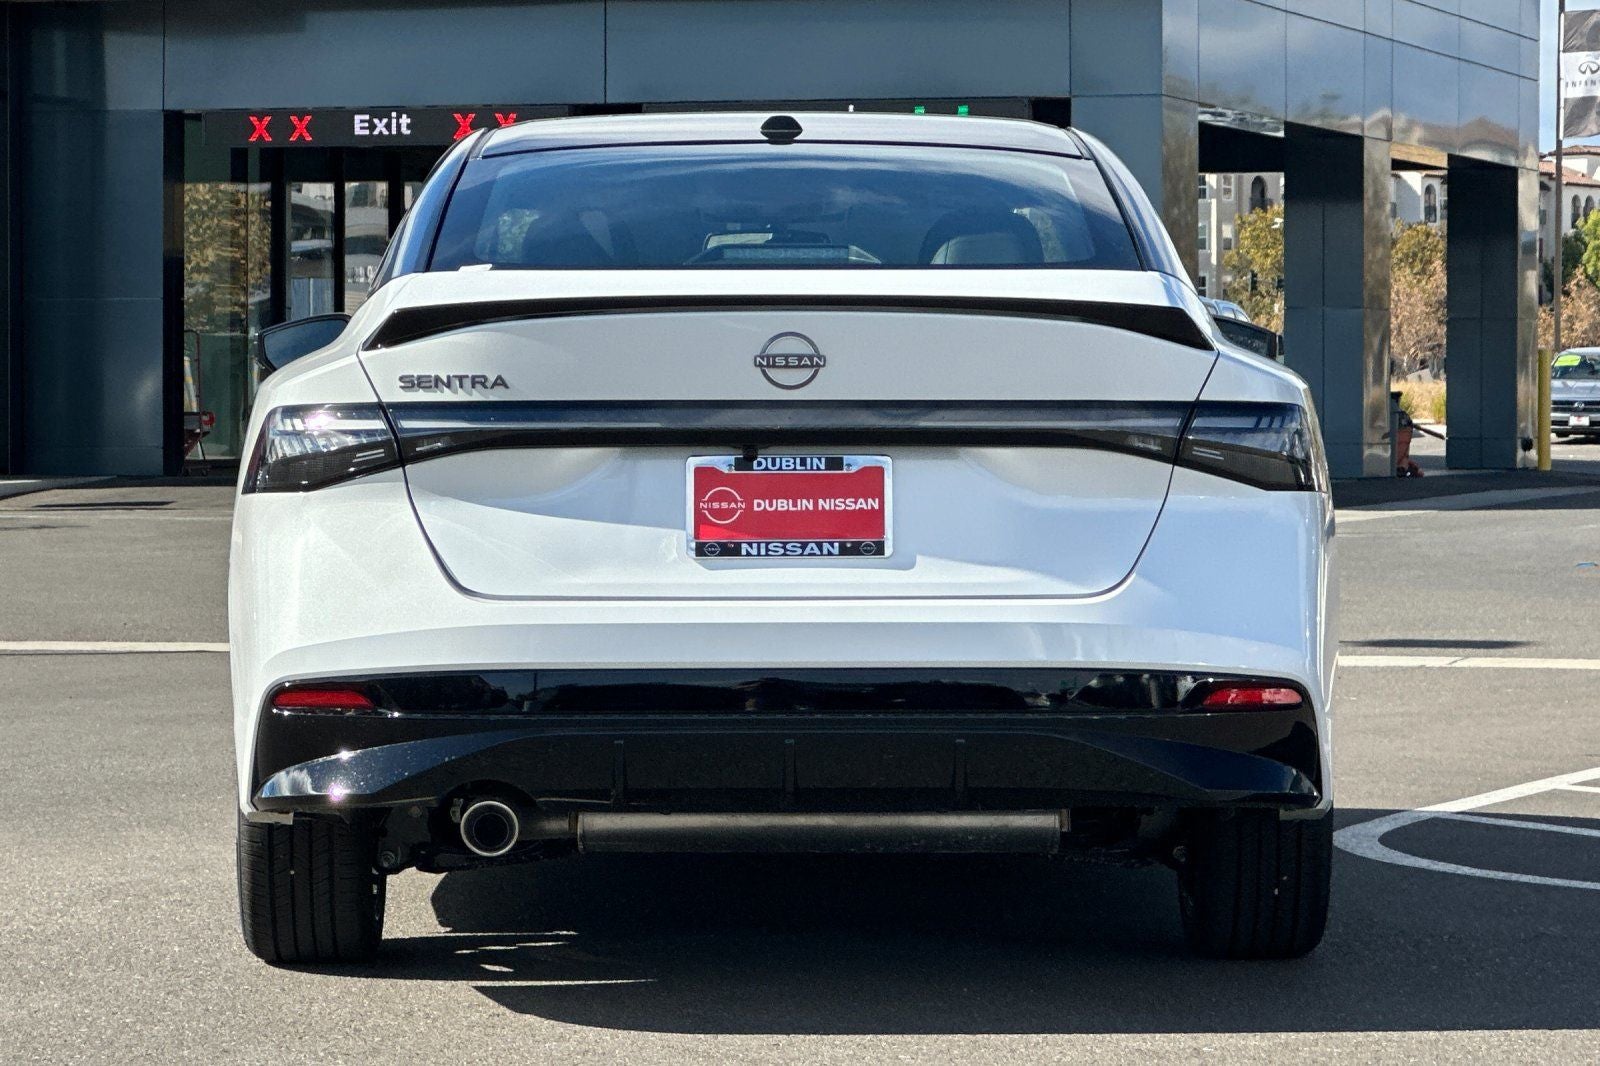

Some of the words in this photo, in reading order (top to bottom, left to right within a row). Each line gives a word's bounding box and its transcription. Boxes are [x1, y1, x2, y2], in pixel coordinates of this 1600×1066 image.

[1565, 79, 1600, 88] INFIN
[354, 112, 411, 135] Exit
[756, 356, 824, 366] NISSAN
[399, 374, 509, 390] SENTRA
[753, 457, 825, 470] DUBLIN
[753, 499, 814, 511] DUBLIN
[818, 498, 879, 510] NISSAN
[741, 542, 839, 556] NISSAN
